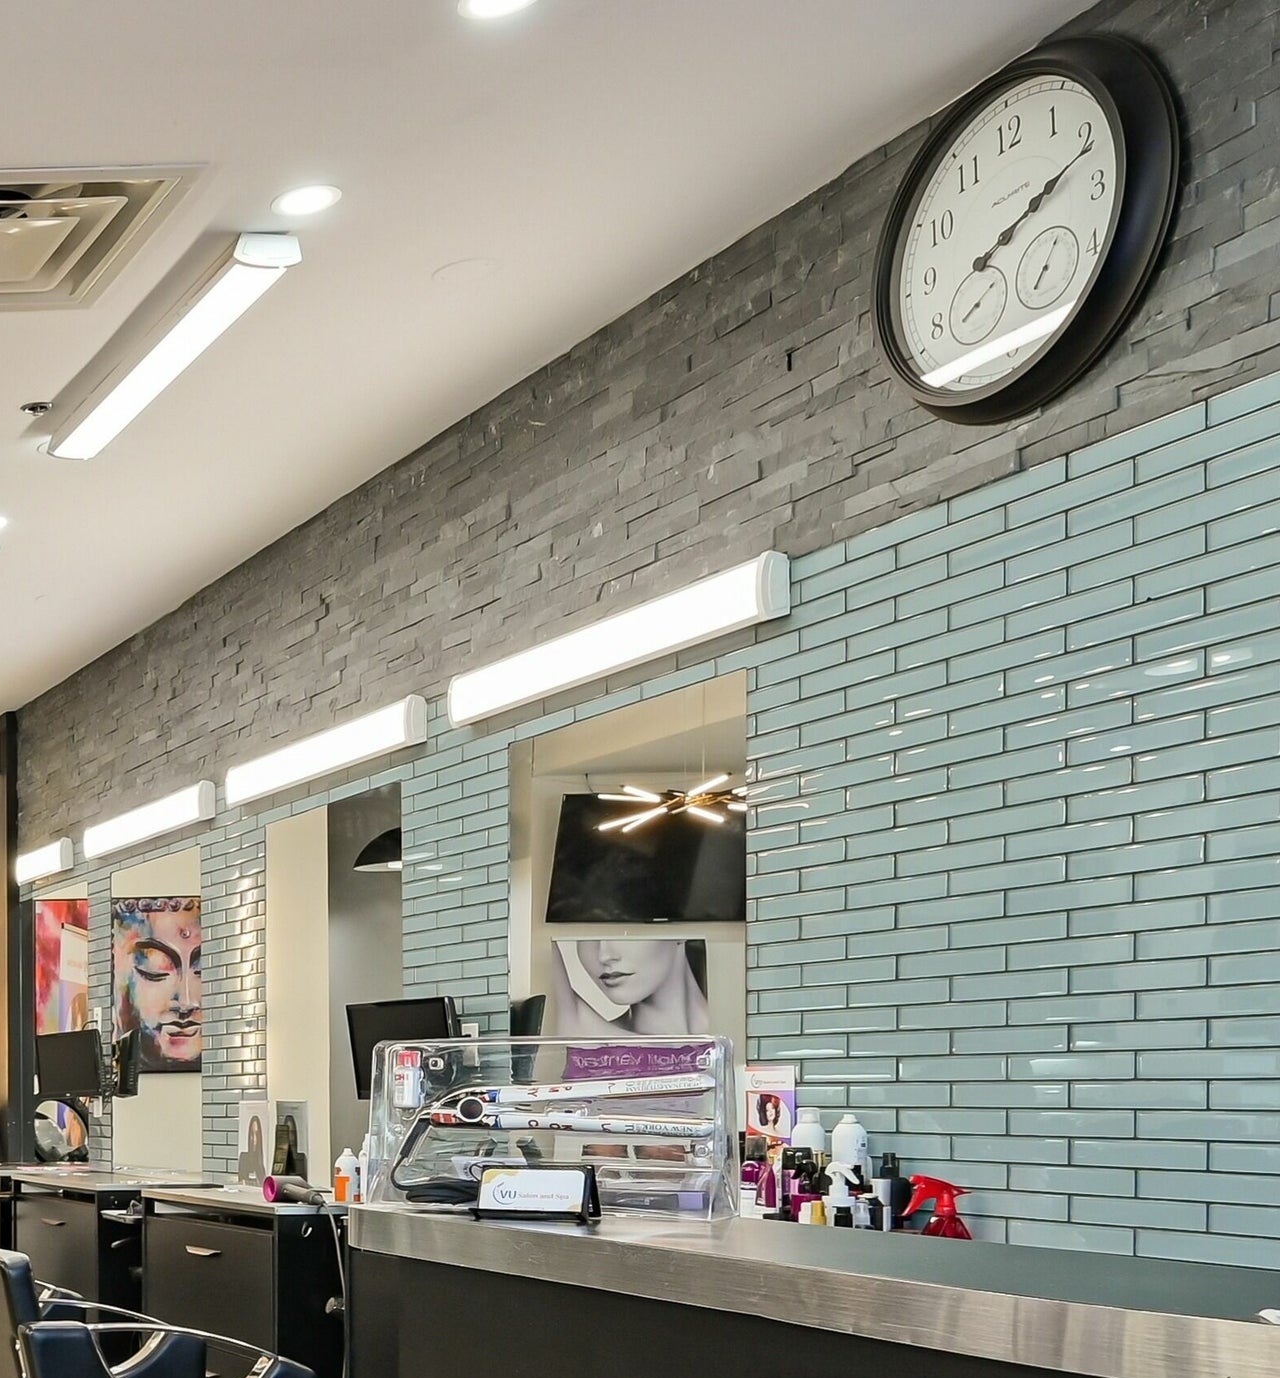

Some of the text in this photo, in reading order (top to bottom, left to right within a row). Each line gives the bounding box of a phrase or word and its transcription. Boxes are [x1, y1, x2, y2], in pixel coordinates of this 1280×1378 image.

[995, 115, 1022, 156] 12
[1048, 106, 1058, 138] 1
[957, 155, 980, 194] 11
[1091, 170, 1105, 200] 3
[930, 209, 954, 248] 10
[1086, 228, 1101, 257] 4
[923, 267, 937, 296] 9
[931, 312, 943, 340] 8
[500, 1190, 517, 1199] VU
